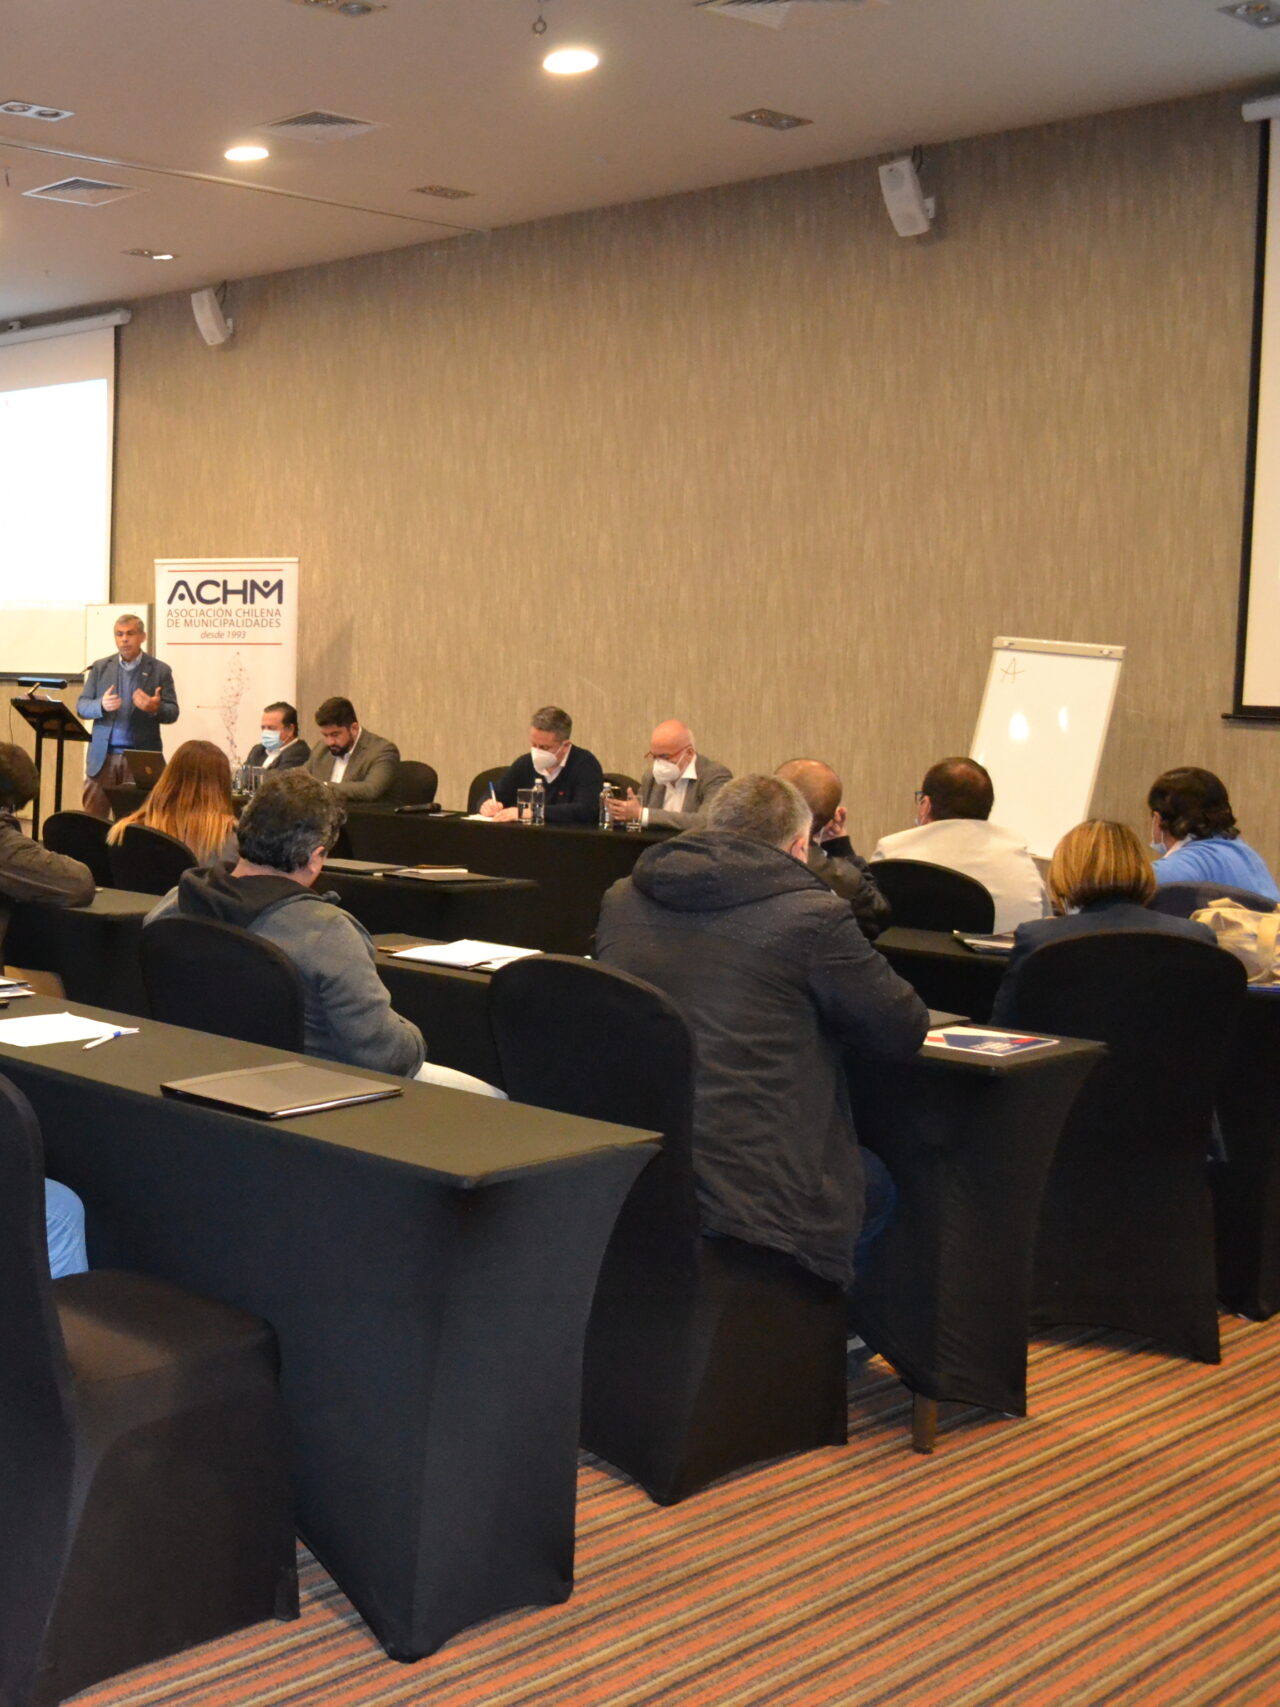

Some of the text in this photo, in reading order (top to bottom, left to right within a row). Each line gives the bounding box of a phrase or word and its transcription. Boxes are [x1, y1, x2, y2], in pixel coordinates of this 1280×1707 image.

[167, 579, 283, 605] ACHM
[167, 607, 281, 618] ASOCIACIÓN CHILENA
[167, 618, 281, 628] DE MUNICIPALIDADES
[200, 630, 246, 639] desde 1993
